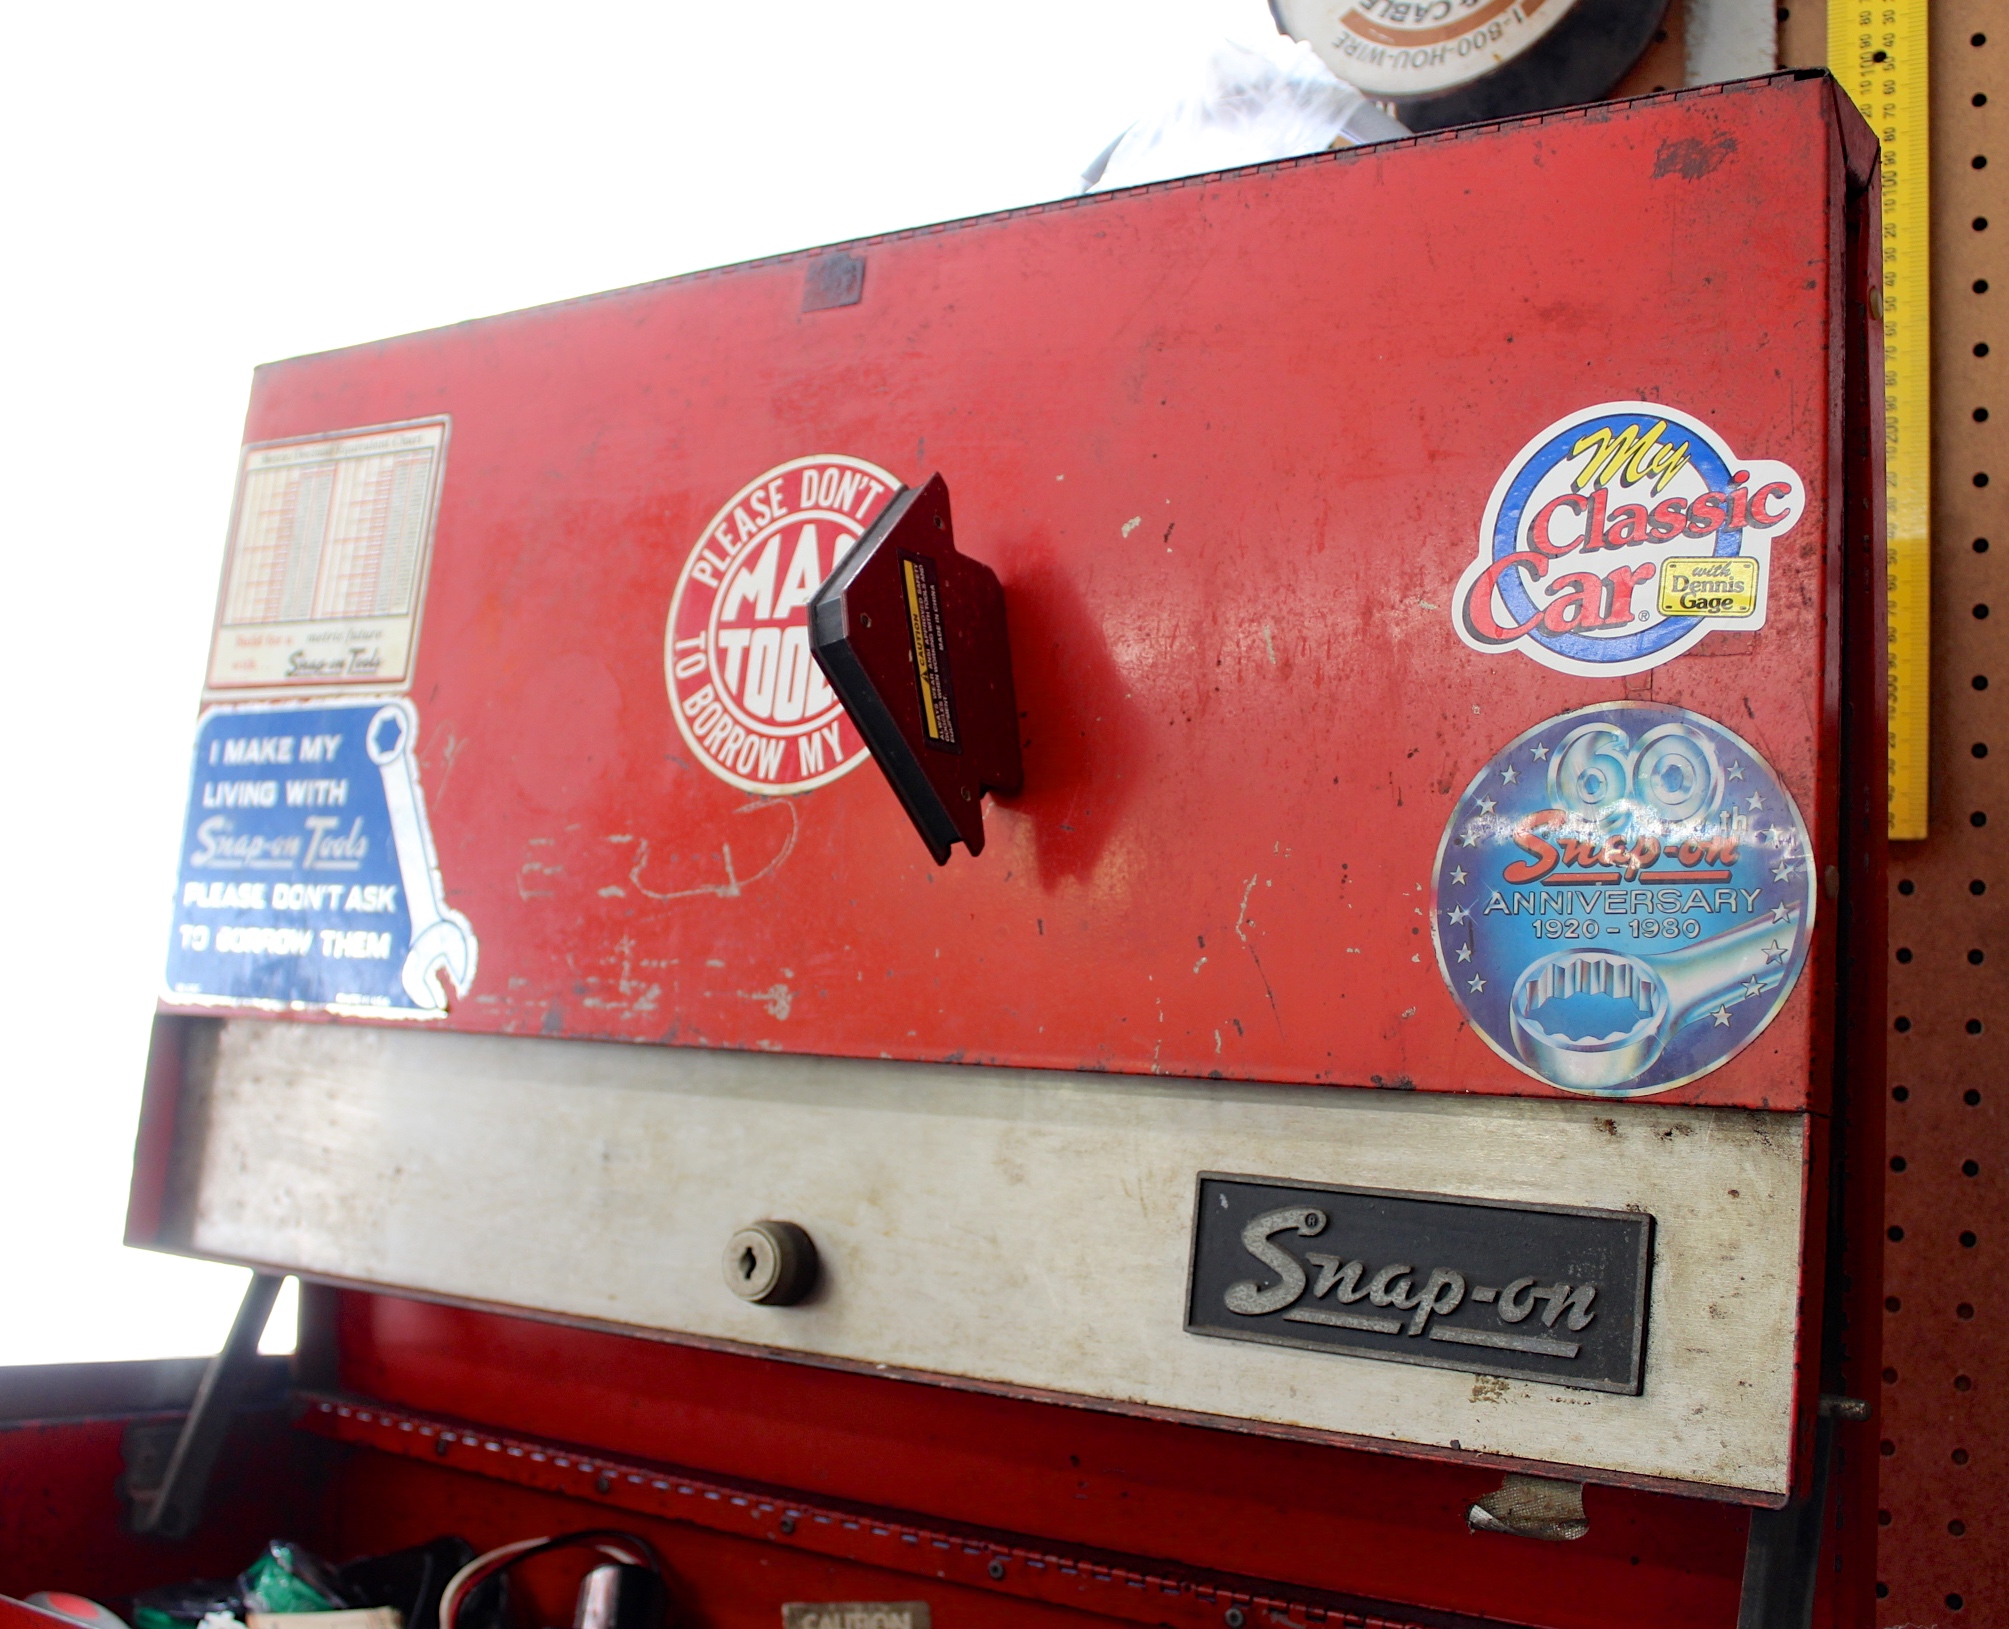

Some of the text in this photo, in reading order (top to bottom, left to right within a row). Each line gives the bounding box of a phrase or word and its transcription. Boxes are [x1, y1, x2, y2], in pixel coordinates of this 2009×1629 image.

[1859, 10, 1872, 25] 80
[1859, 34, 1872, 48] 90
[1570, 420, 1691, 496] My
[691, 467, 885, 588] PLEASE DON'T
[1527, 470, 1792, 558] Classic
[1671, 575, 1745, 595] Dennis
[1692, 560, 1733, 578] with
[1462, 550, 1656, 645] Car
[1680, 592, 1734, 613] Gage
[912, 614, 925, 666] CAUTION
[675, 630, 844, 780] TO BORROW MY
[208, 734, 342, 766] I MAKE MY
[1546, 722, 1725, 824] 60
[203, 778, 348, 808] LIVING WITH
[190, 815, 369, 870] Snap-on Tools
[183, 882, 399, 913] PLEASE DON'T ASK
[1484, 888, 1763, 916] ANNIVERSARY
[179, 924, 211, 951] TO
[319, 928, 393, 959] THEM
[1533, 918, 1600, 940] 1920
[1629, 917, 1701, 939] 1980
[1224, 1206, 1597, 1344] Snap-on
